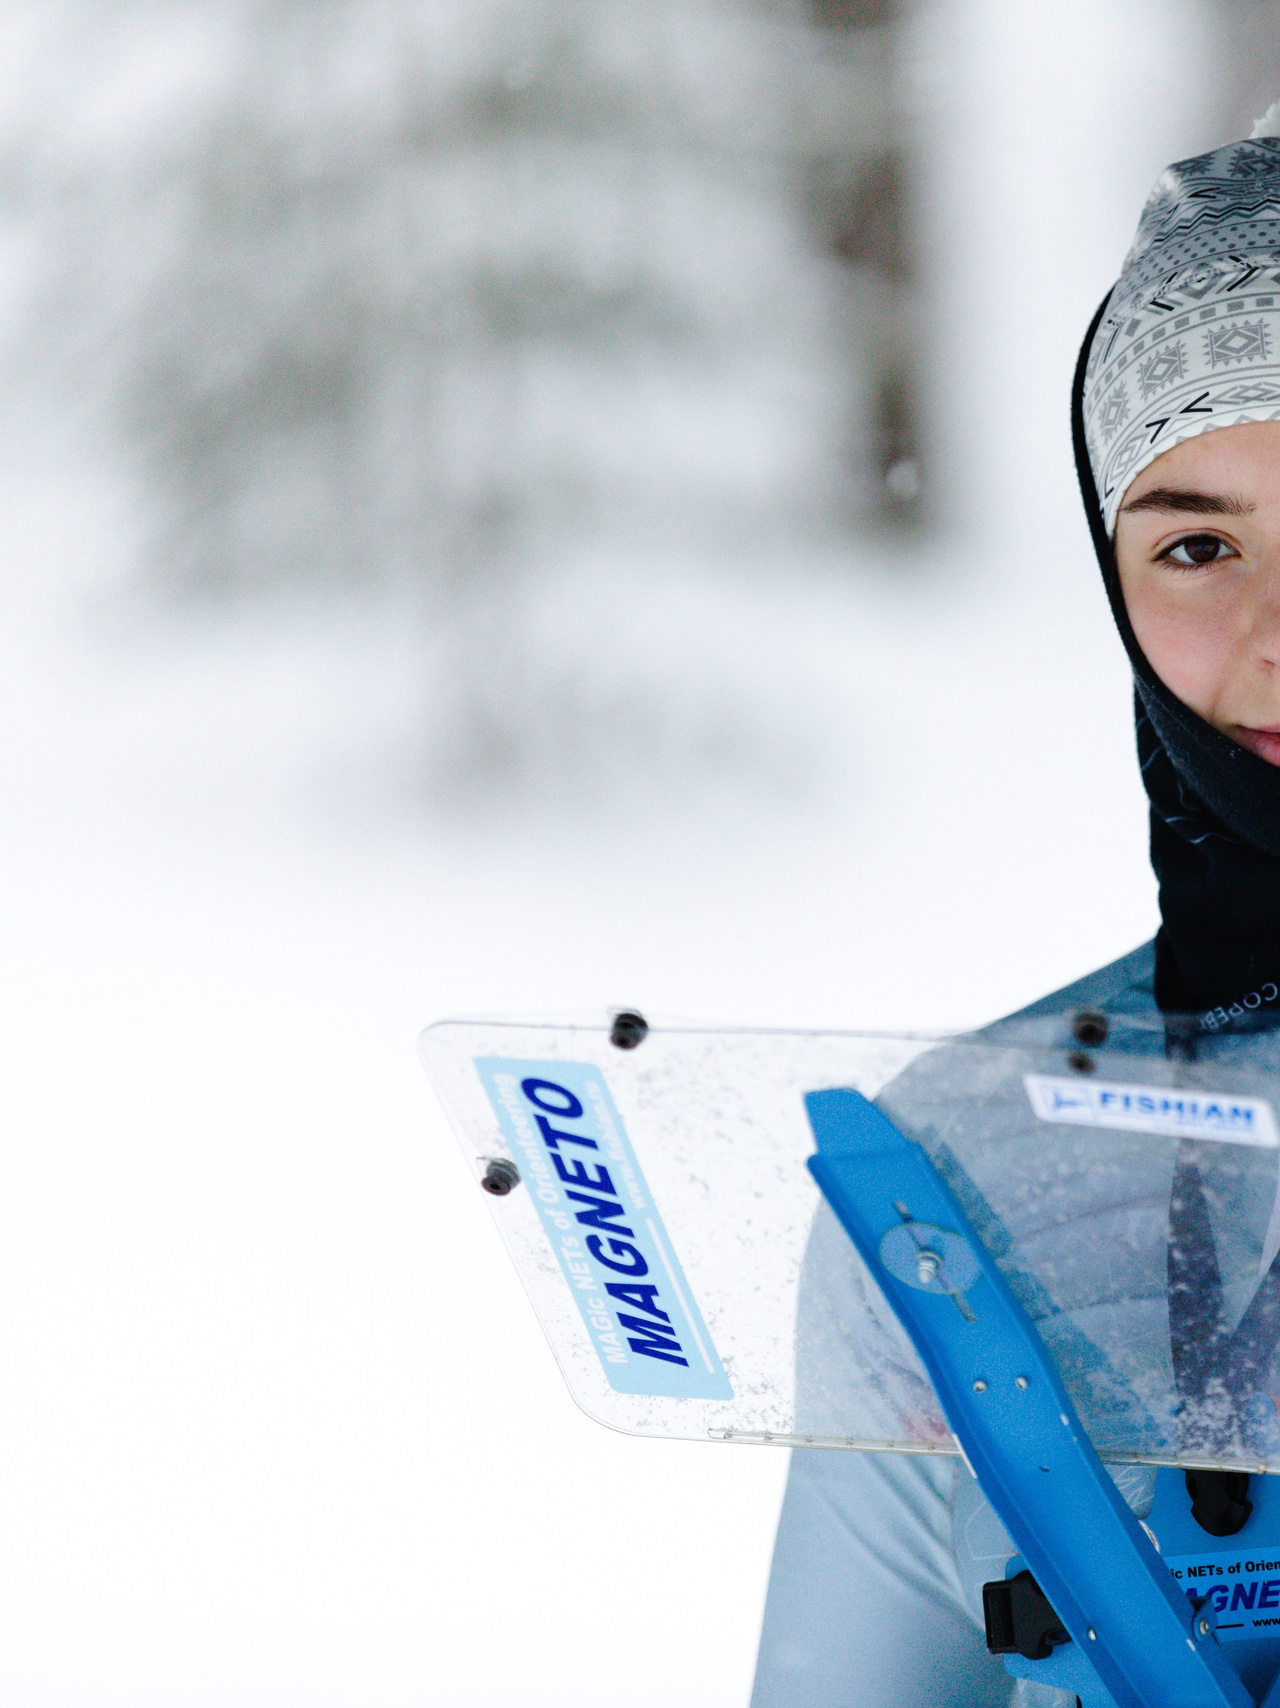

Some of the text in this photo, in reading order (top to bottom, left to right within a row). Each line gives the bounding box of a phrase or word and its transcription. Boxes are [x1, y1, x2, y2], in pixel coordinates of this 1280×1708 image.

[522, 1078, 690, 1367] MAGNETO
[548, 1207, 572, 1231] of
[562, 1238, 597, 1290] NETs
[1187, 1564, 1224, 1578] NETs
[1227, 1561, 1242, 1575] of
